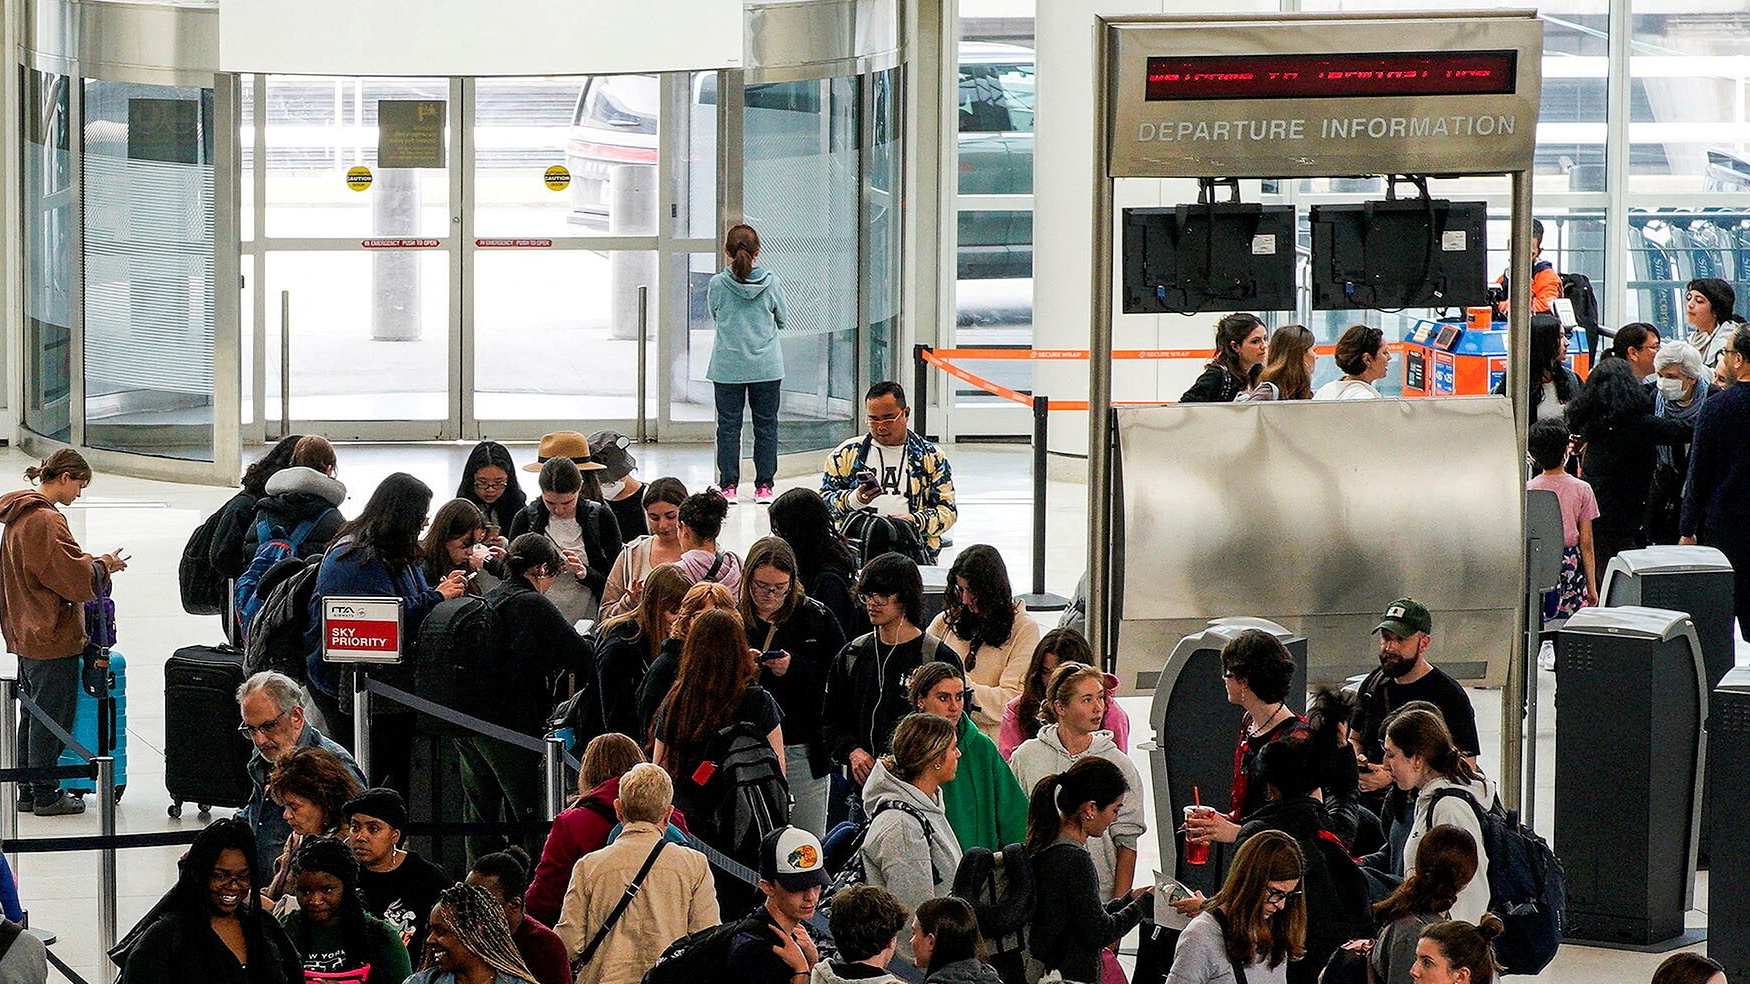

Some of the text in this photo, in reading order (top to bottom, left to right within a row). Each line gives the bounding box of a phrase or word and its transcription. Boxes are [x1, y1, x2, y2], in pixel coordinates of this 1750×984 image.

[1137, 115, 1516, 143] DEPARTURE INFORMATION
[331, 627, 356, 637] SKY
[331, 637, 387, 647] PRIORITY
[321, 949, 347, 960] YORK
